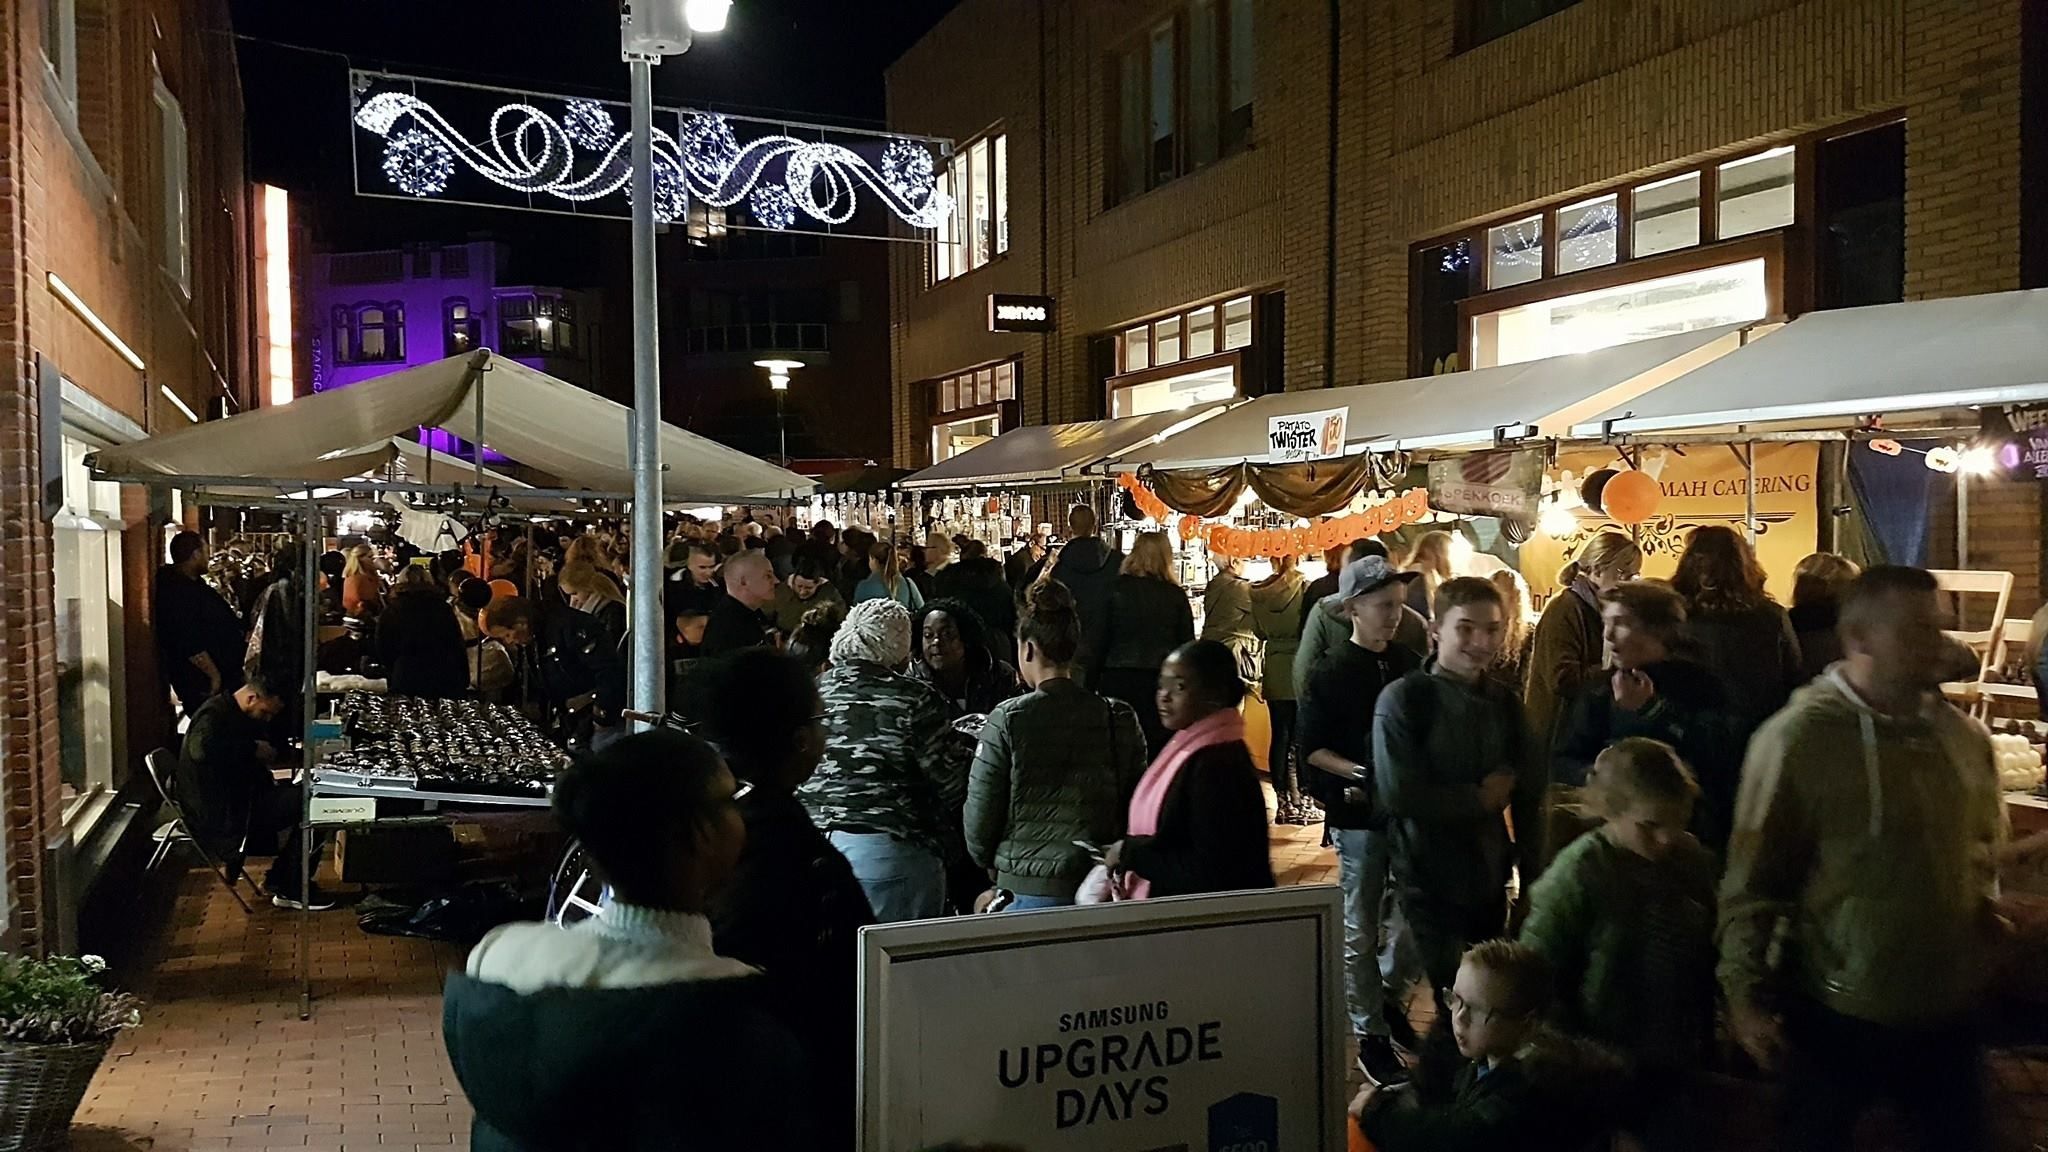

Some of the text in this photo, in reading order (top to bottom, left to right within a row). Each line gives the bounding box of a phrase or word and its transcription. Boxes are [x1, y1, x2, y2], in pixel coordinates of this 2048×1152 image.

[1277, 420, 1311, 431] PATATO
[1269, 429, 1317, 450] TWISTER
[1713, 474, 1811, 497] CATERING
[1059, 1001, 1169, 1032] SAMSUNG
[999, 1021, 1223, 1088] UPGRADE
[1056, 1075, 1169, 1129] DAYS
